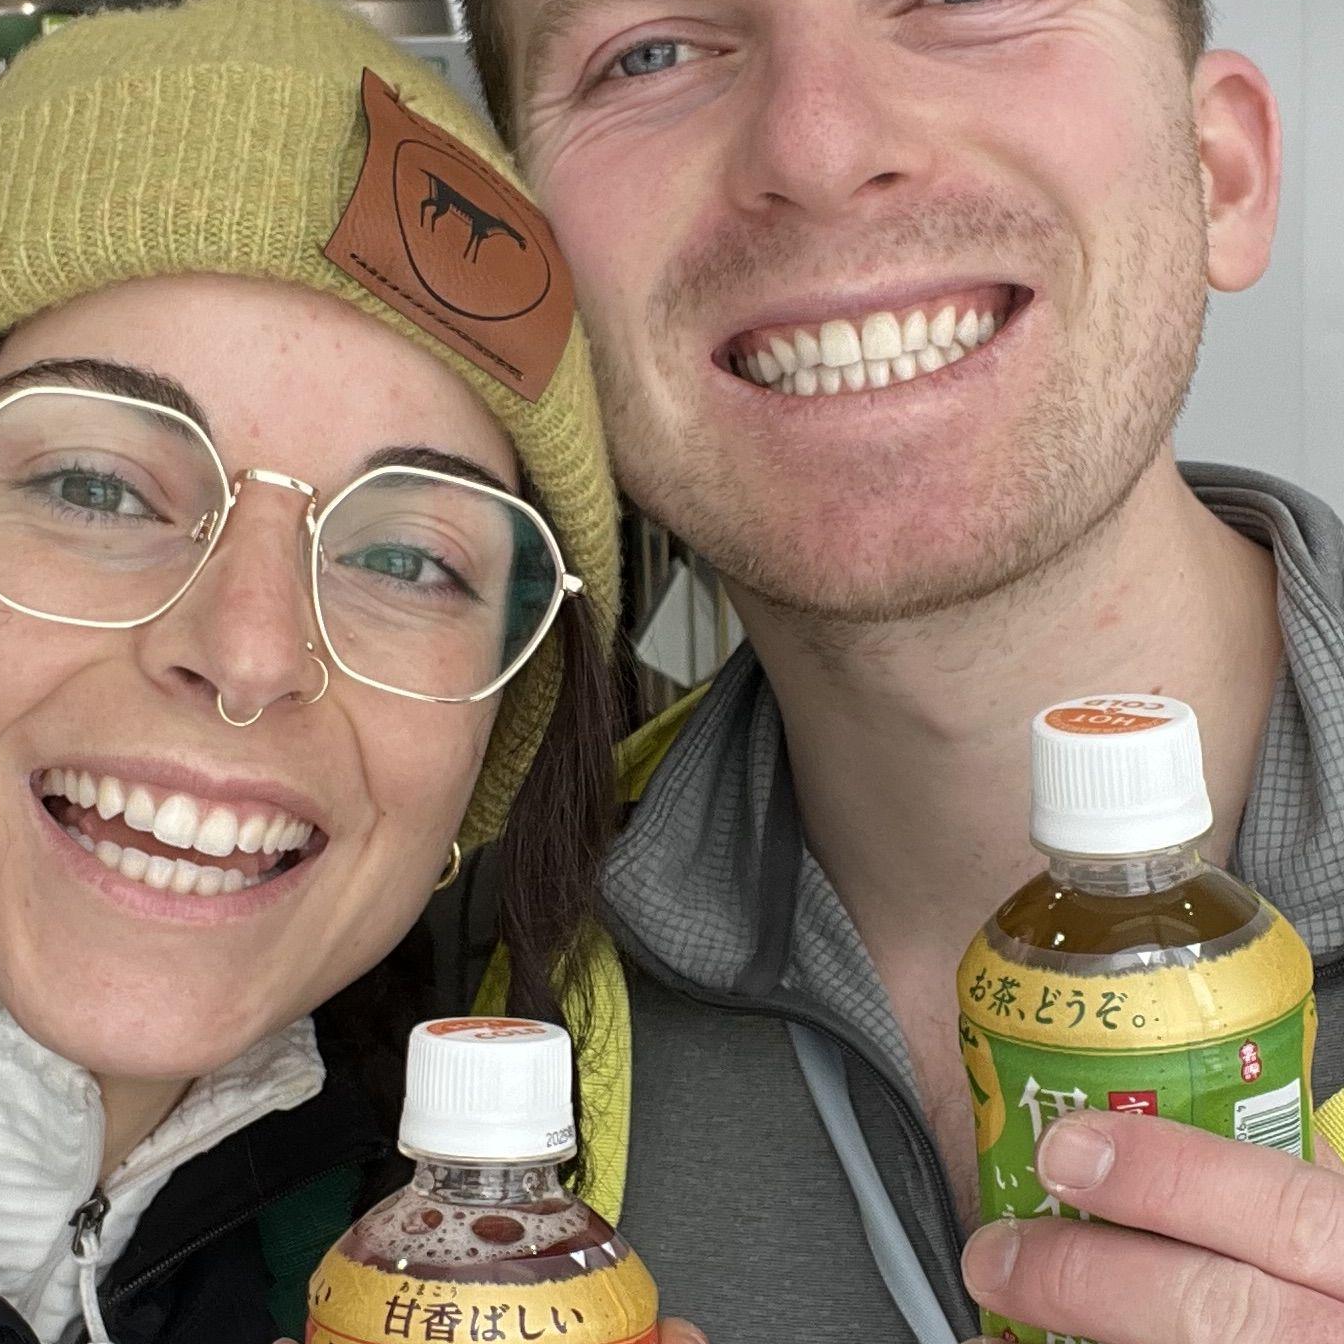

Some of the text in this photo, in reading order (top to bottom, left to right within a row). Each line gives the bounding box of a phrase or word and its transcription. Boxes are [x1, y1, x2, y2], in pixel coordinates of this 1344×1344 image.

[969, 967, 1146, 1030] お茶、どうぞ。
[384, 1295, 584, 1343] 甘香ばしい
